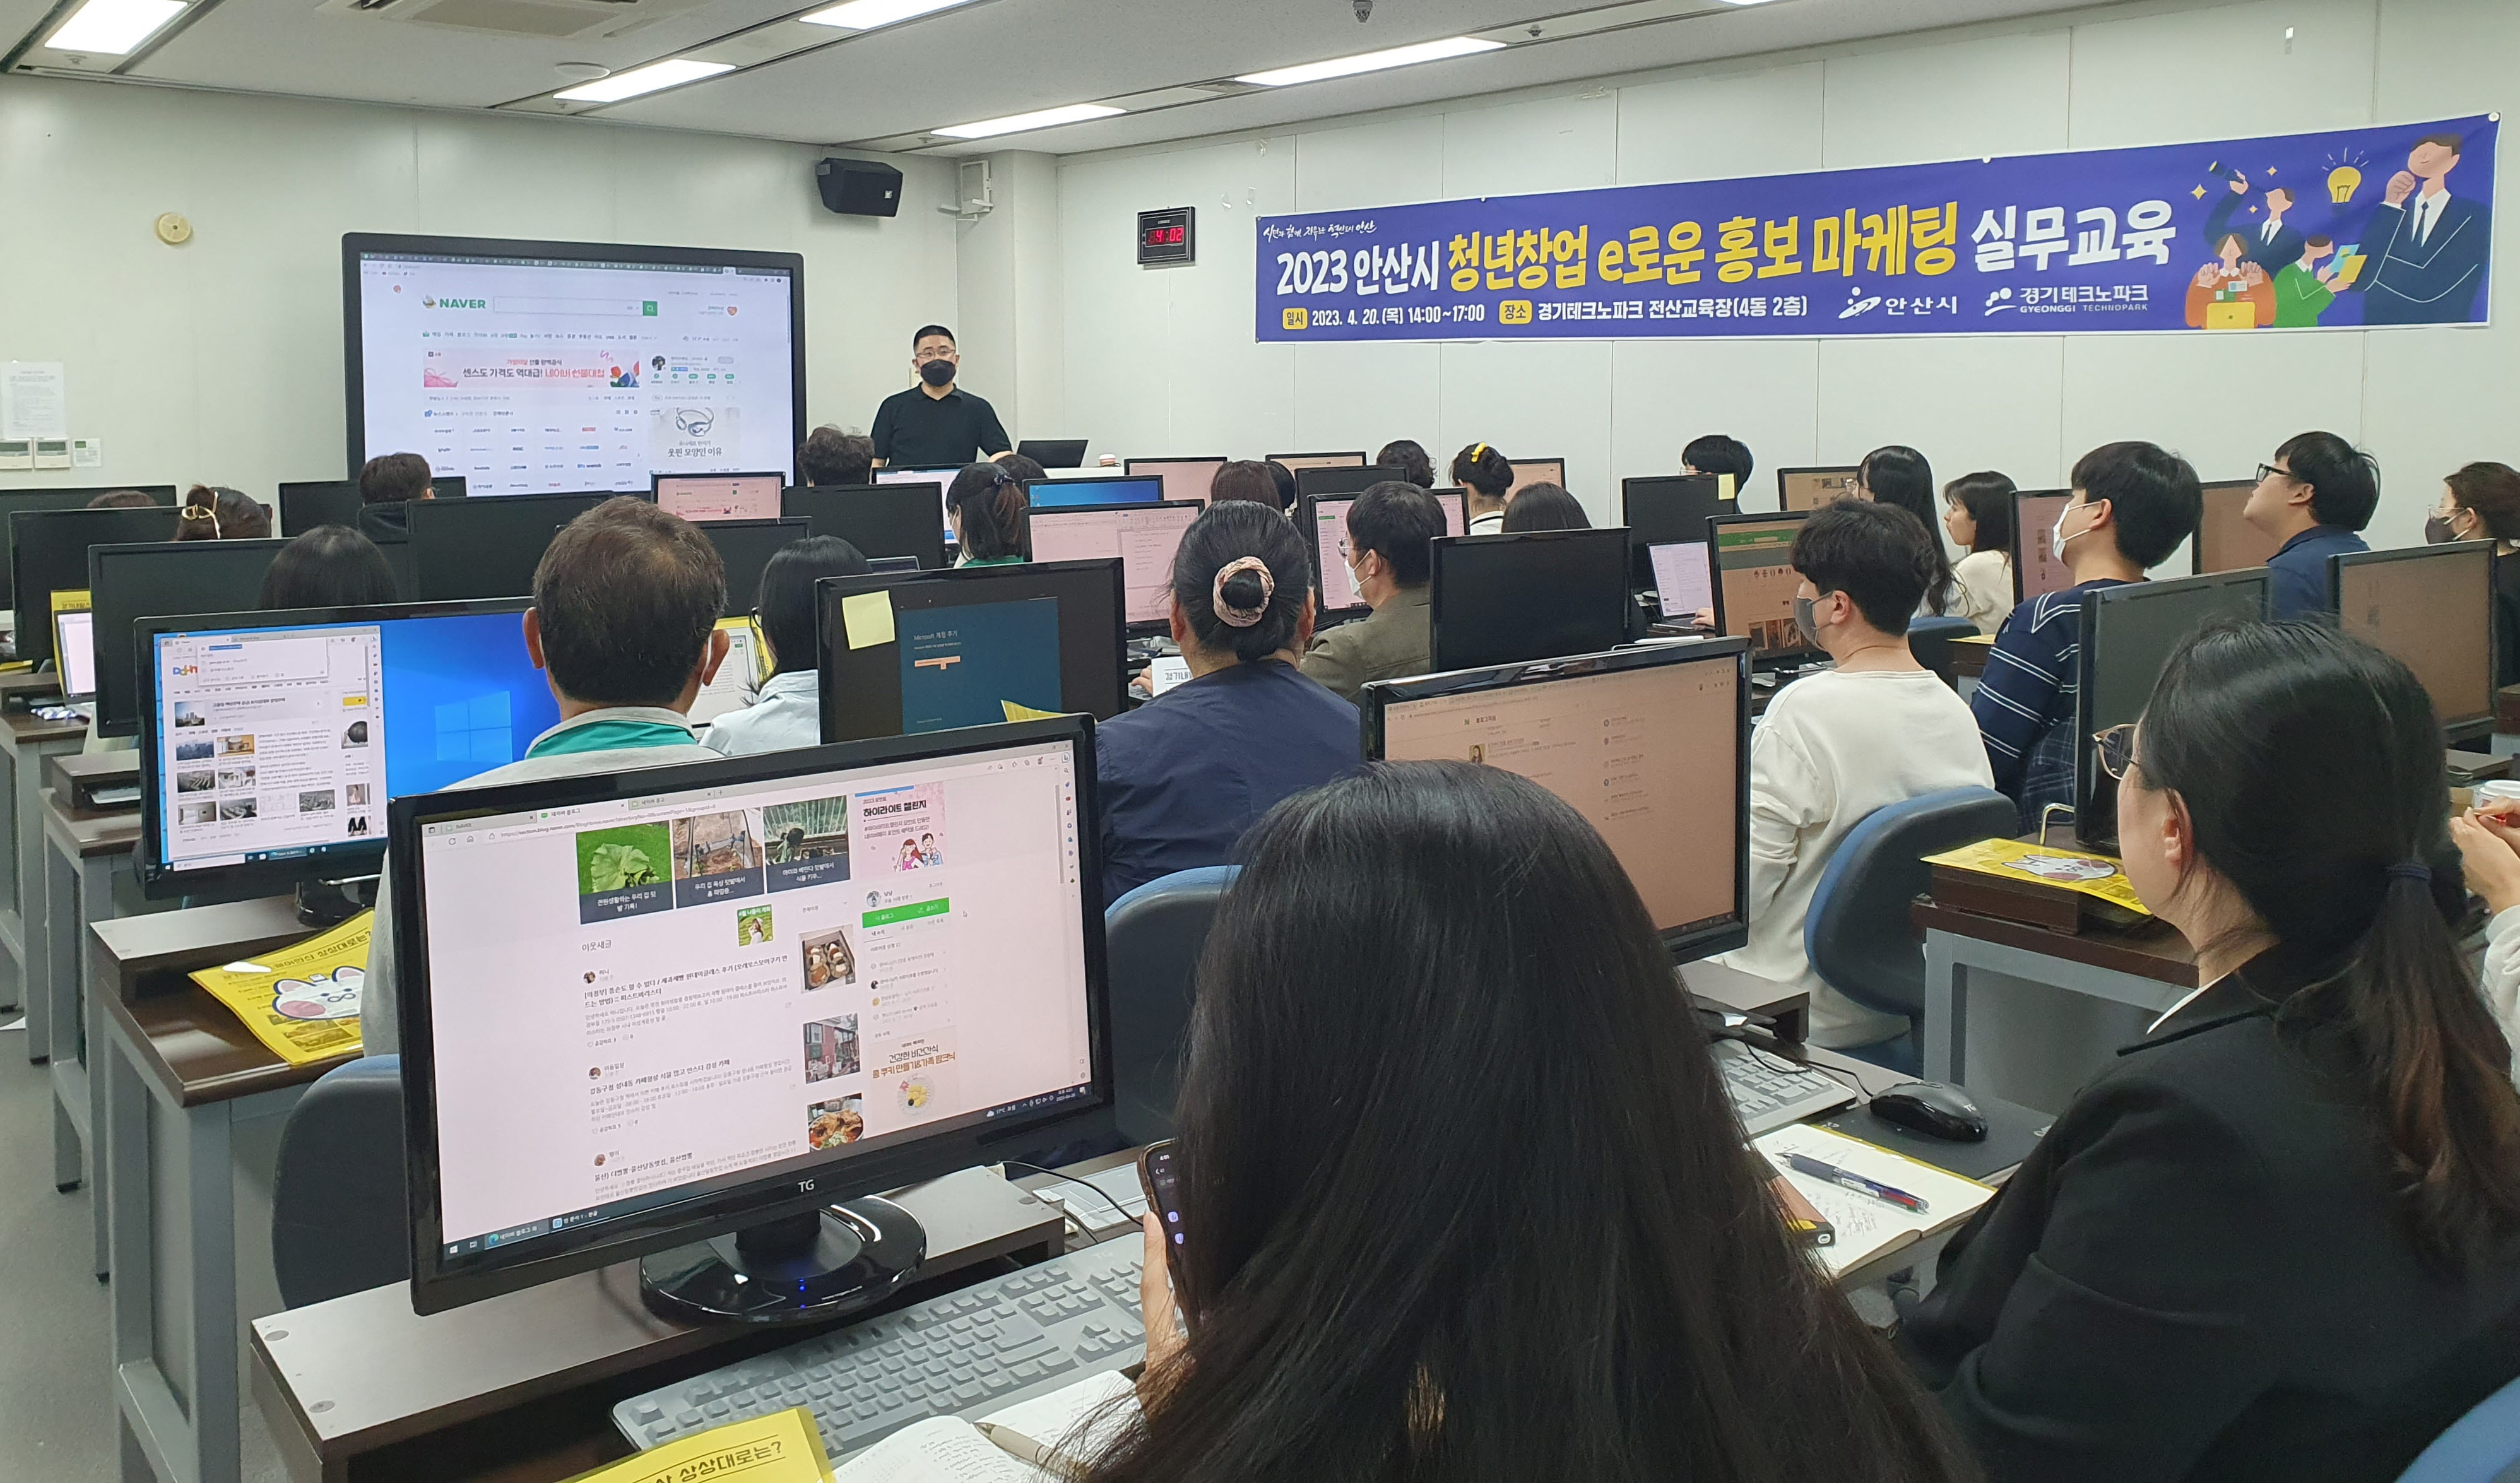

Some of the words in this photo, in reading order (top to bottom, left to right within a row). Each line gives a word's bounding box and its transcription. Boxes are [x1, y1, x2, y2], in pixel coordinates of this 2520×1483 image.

[1356, 220, 1377, 233] 안산
[1277, 249, 1348, 295] 2023
[1354, 245, 1440, 295] 안산시
[1448, 225, 1588, 292] 청년창업
[1599, 222, 1705, 285] e로운
[1715, 215, 1802, 283] 홍보
[1813, 201, 1958, 276] 마케팅
[1972, 199, 2176, 273] 실무교육
[2020, 285, 2148, 304] 경기테크노파크
[439, 298, 486, 309] NAVER
[1504, 305, 1526, 320] 장소
[1538, 300, 1643, 321] 경기테크노파크
[1649, 297, 1766, 319] 전산교육장(4동
[1772, 295, 1807, 317] 2층)
[1885, 295, 1957, 316] 안산시
[2020, 304, 2076, 313] GYEONGGI
[2083, 303, 2148, 312] TECHNOPARK
[1286, 312, 1303, 326] 일시
[1312, 310, 1343, 326] 2023.
[1347, 310, 1358, 325] 4.
[1408, 304, 1485, 324] 14:00~17:00
[463, 368, 488, 379] 센스도
[490, 368, 514, 379] 가격도
[707, 447, 723, 456] 이유
[863, 803, 902, 817] 하이라이트
[903, 800, 926, 812] 챌린지
[581, 938, 612, 952] 이웃새글
[798, 1179, 815, 1192] TG
[679, 1441, 782, 1482] 상상대로는?
